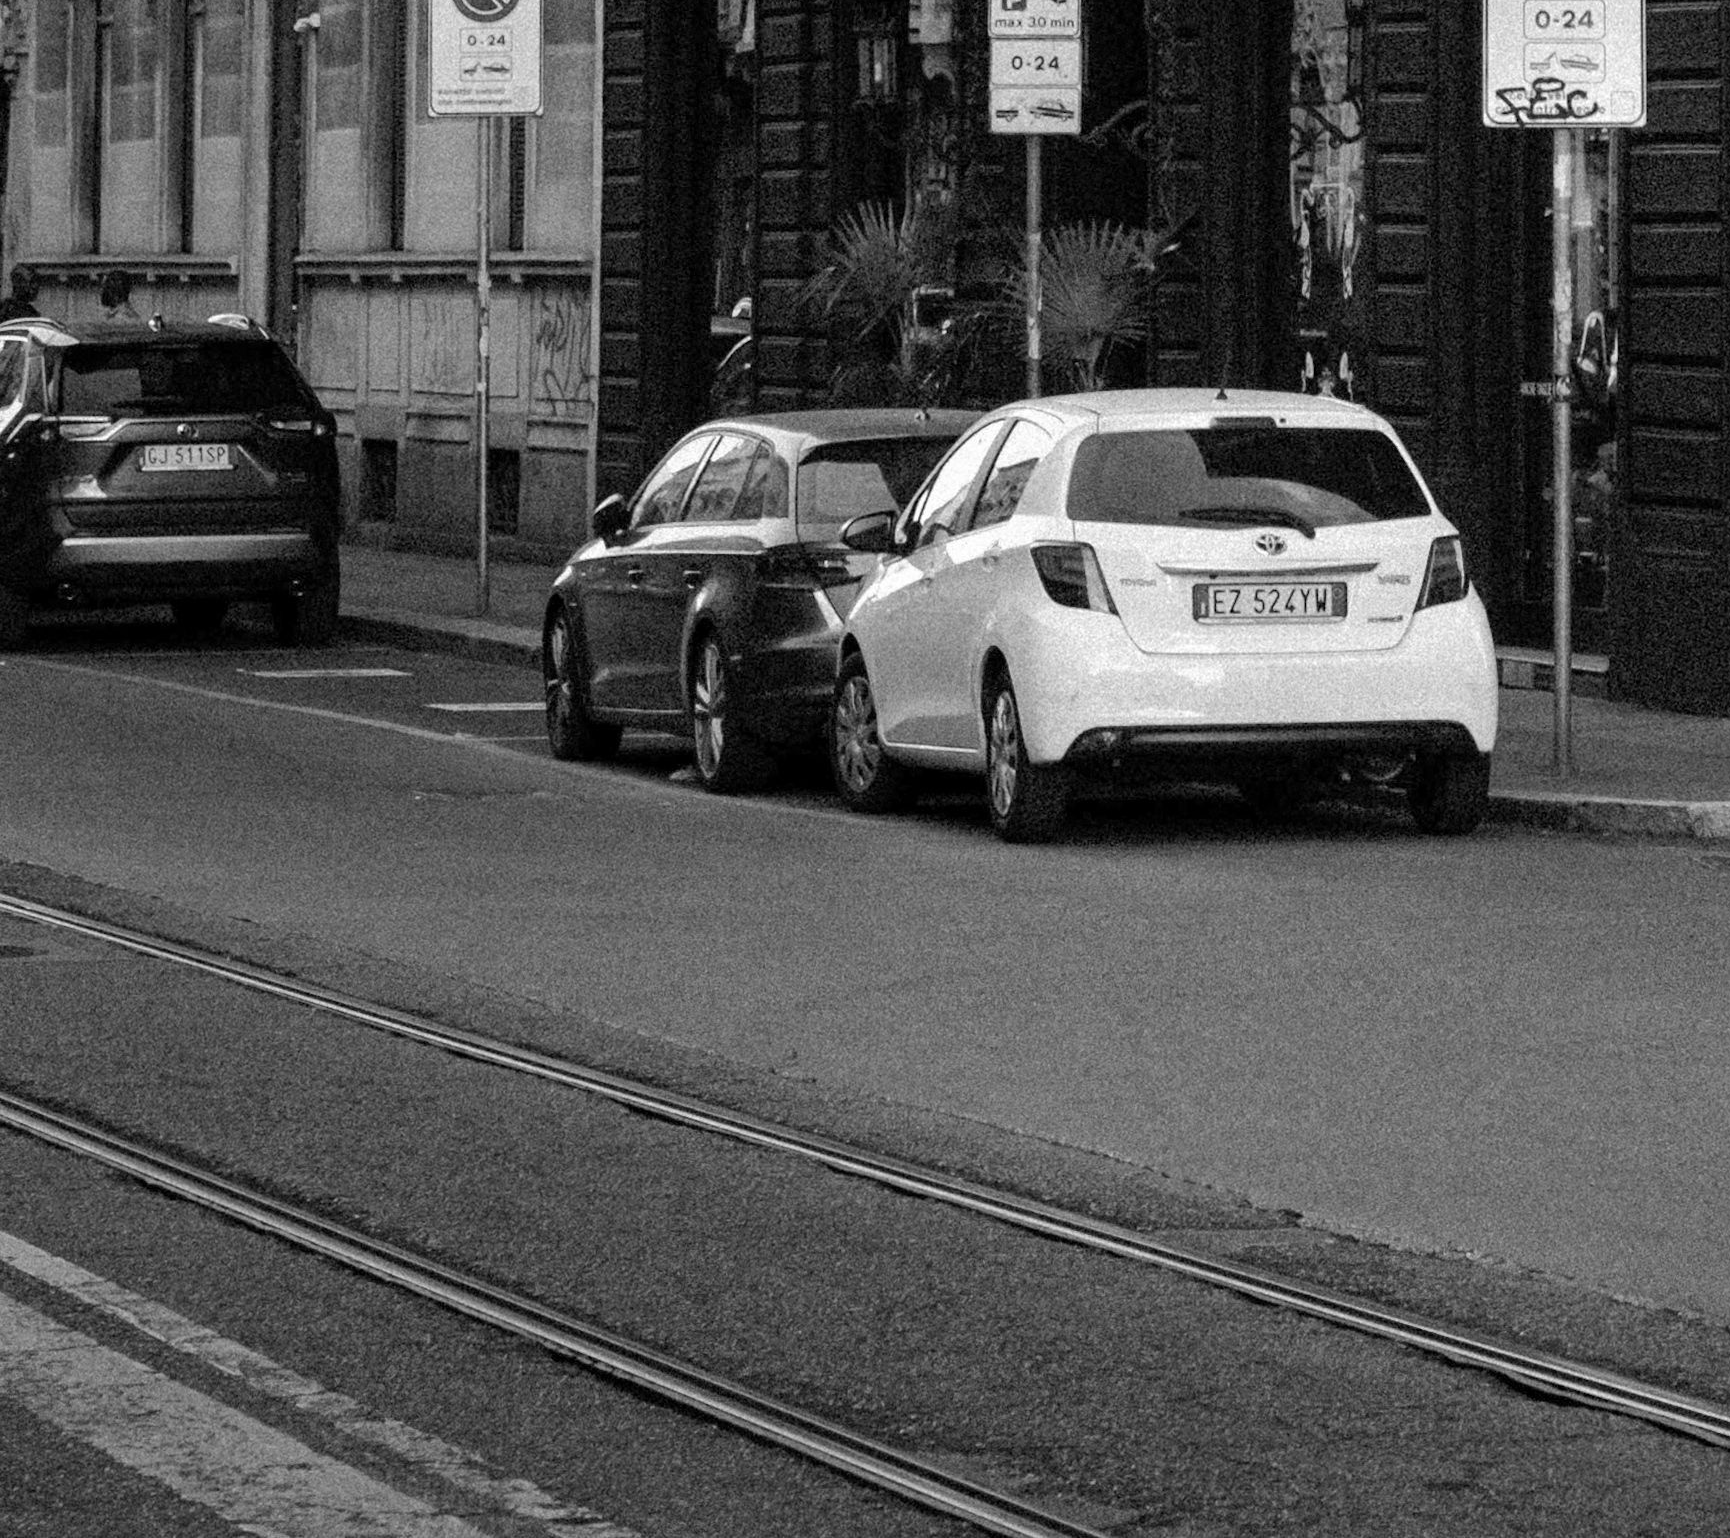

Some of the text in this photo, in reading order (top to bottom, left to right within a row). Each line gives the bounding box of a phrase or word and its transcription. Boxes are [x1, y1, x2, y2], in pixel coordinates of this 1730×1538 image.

[995, 16, 1075, 29] max 30 min
[1534, 9, 1594, 29] 0-24
[1011, 55, 1060, 71] 0-24
[148, 447, 168, 464] GJ
[1213, 588, 1327, 614] EZ 524YW
